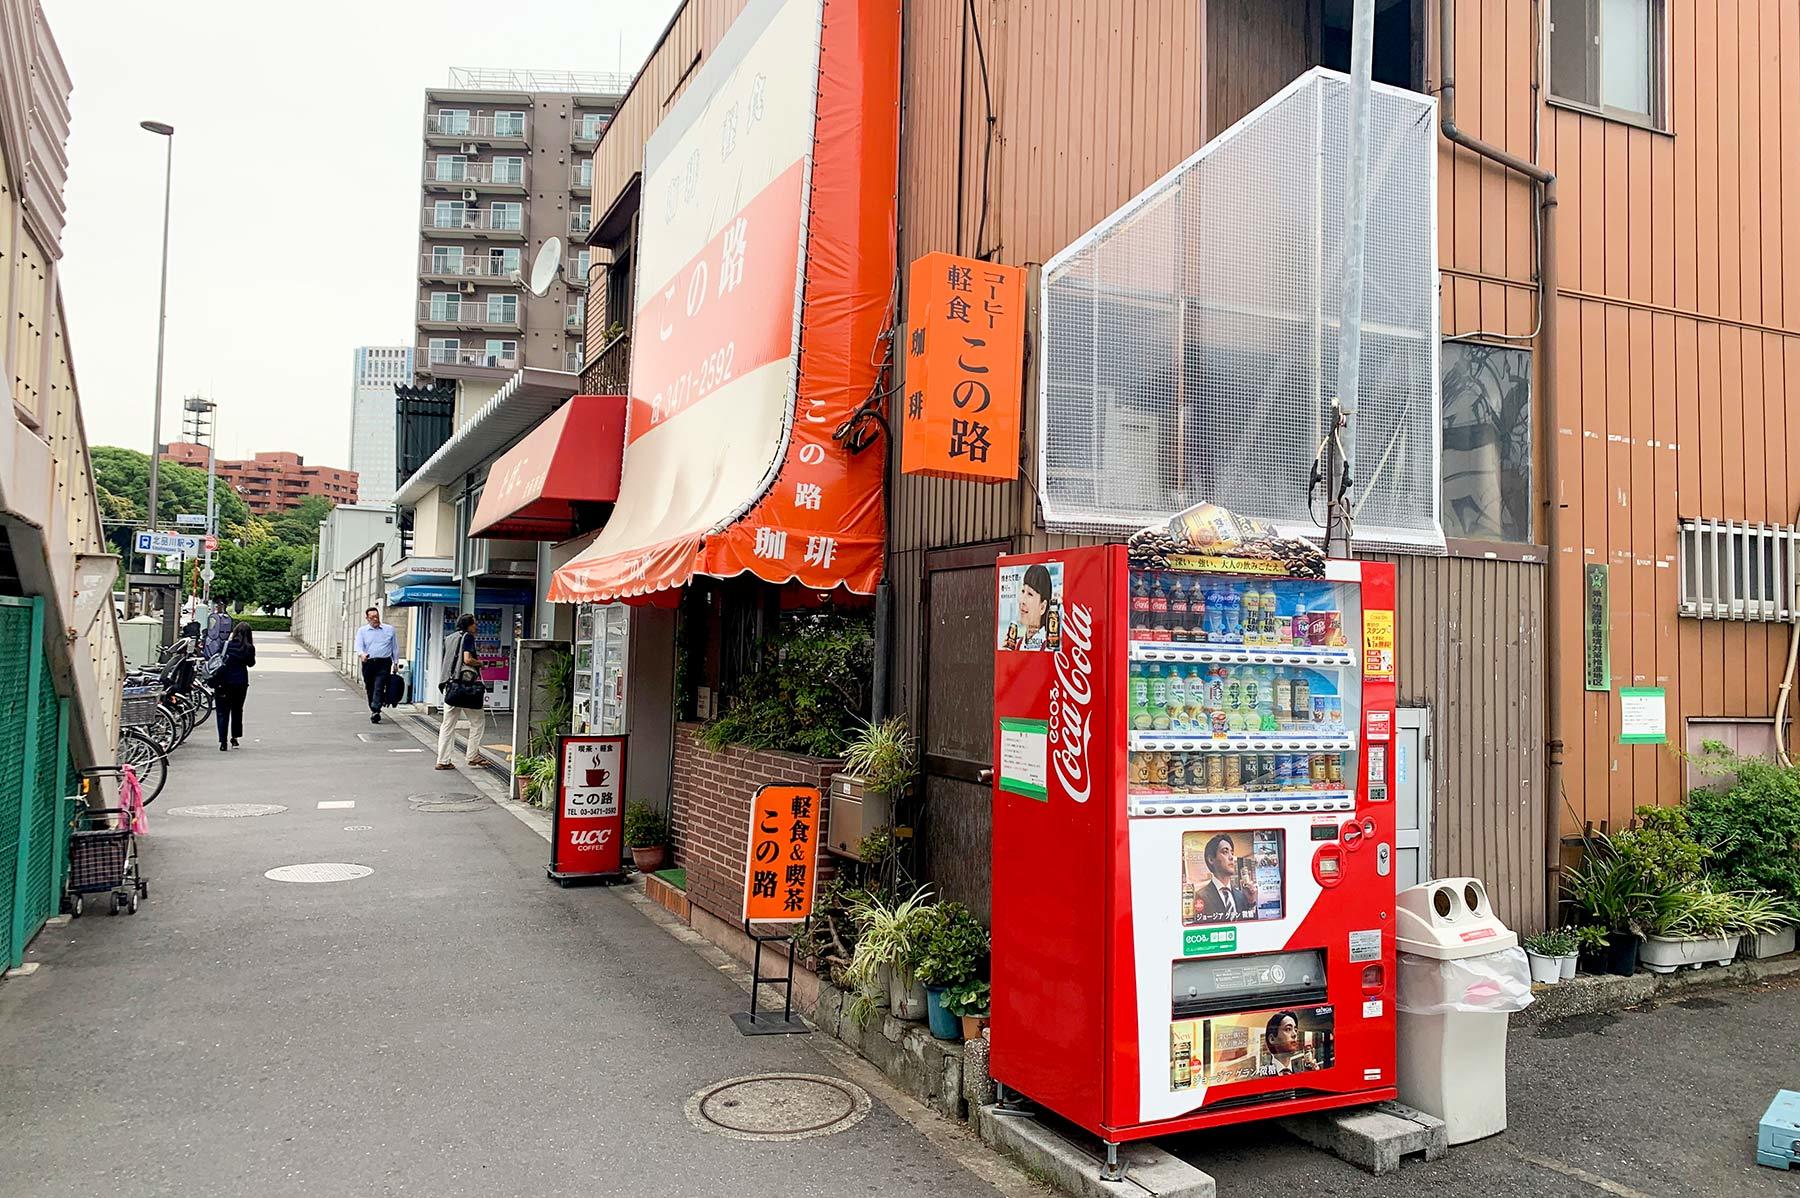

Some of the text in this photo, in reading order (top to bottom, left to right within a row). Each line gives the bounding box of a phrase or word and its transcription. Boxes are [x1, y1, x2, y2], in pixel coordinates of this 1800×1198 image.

[658, 216, 748, 341] この路
[946, 263, 973, 324] 軽食
[983, 270, 1006, 329] コーヒー
[908, 326, 927, 423] 珈琲
[948, 334, 992, 464] この路
[793, 398, 826, 511] この路
[152, 535, 185, 547] 北品川駅
[752, 526, 839, 570] 珈琲
[567, 806, 617, 816] TEL 03-3471-2592
[572, 792, 614, 805] この路
[577, 844, 604, 852] COFFEE
[751, 809, 780, 899] この路
[783, 795, 813, 912] 軽食&喫茶
